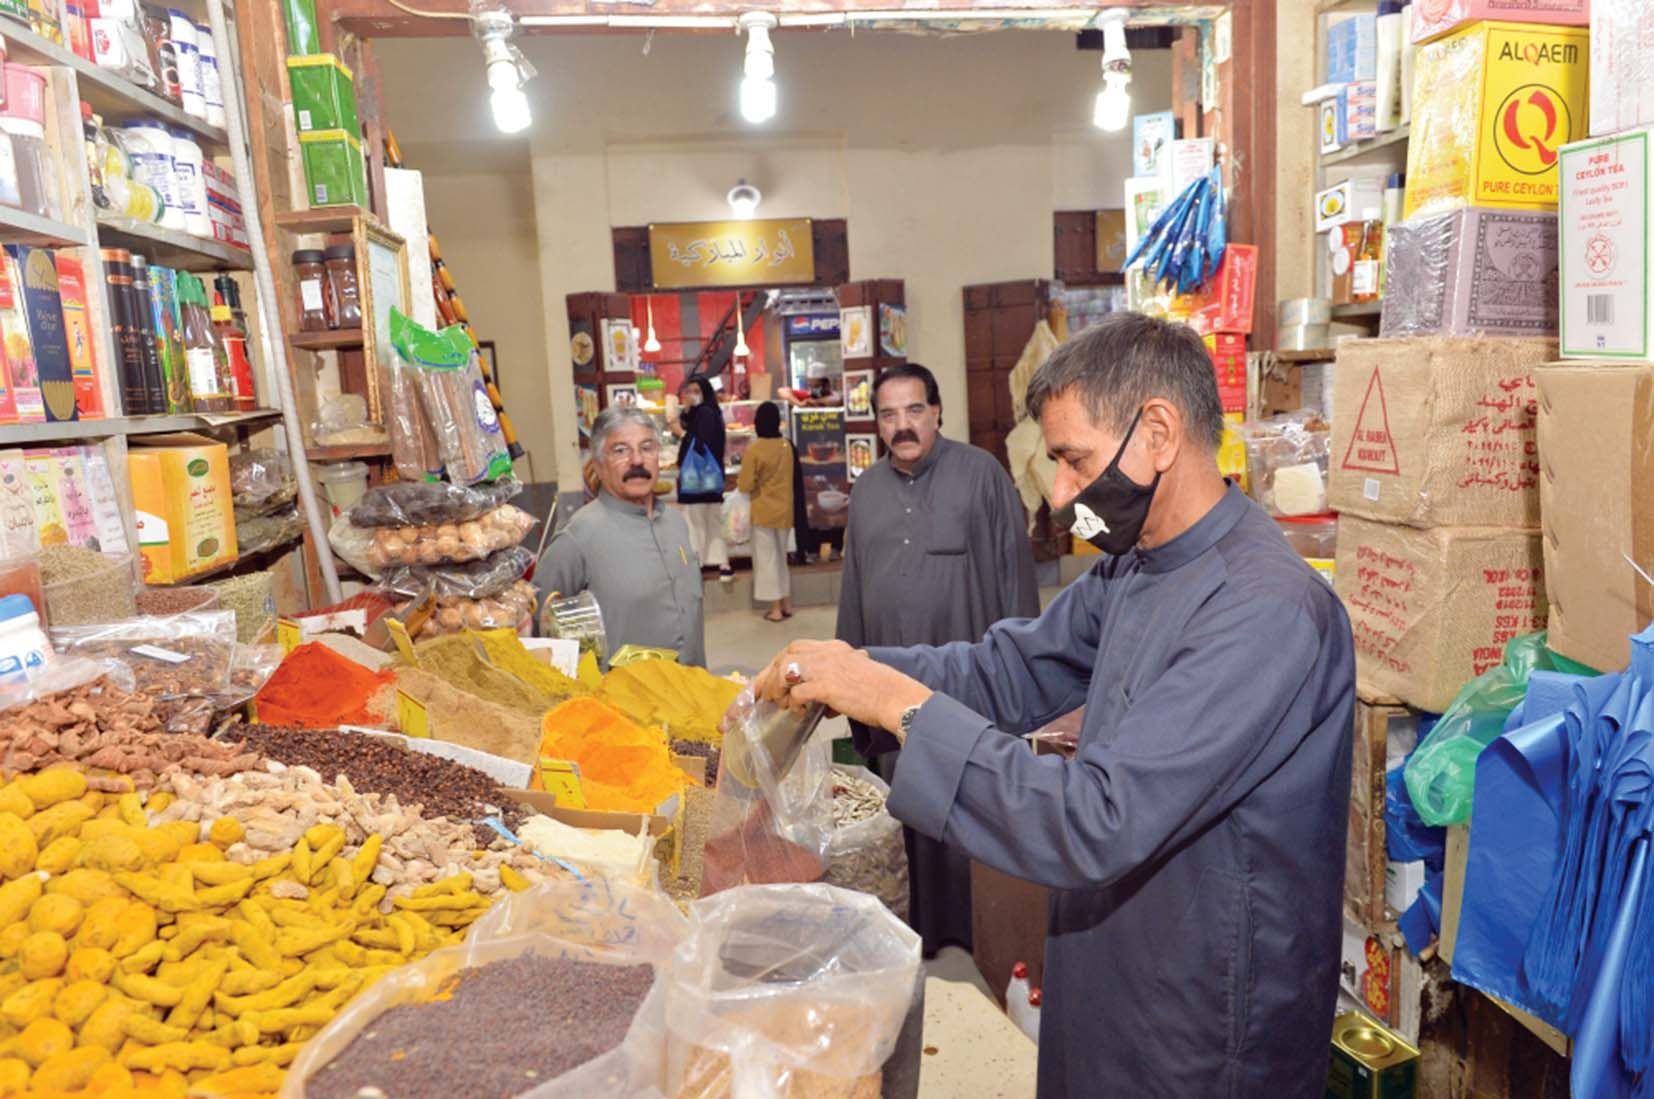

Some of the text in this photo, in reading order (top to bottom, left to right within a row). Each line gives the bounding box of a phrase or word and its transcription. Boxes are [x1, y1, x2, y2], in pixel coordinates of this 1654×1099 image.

[1499, 42, 1578, 66] ALQAEM
[1589, 153, 1609, 164] PURE
[1608, 164, 1625, 175] TEA
[1483, 181, 1511, 193] PURE
[1513, 182, 1553, 195] CEYLON
[811, 318, 840, 331] PEP
